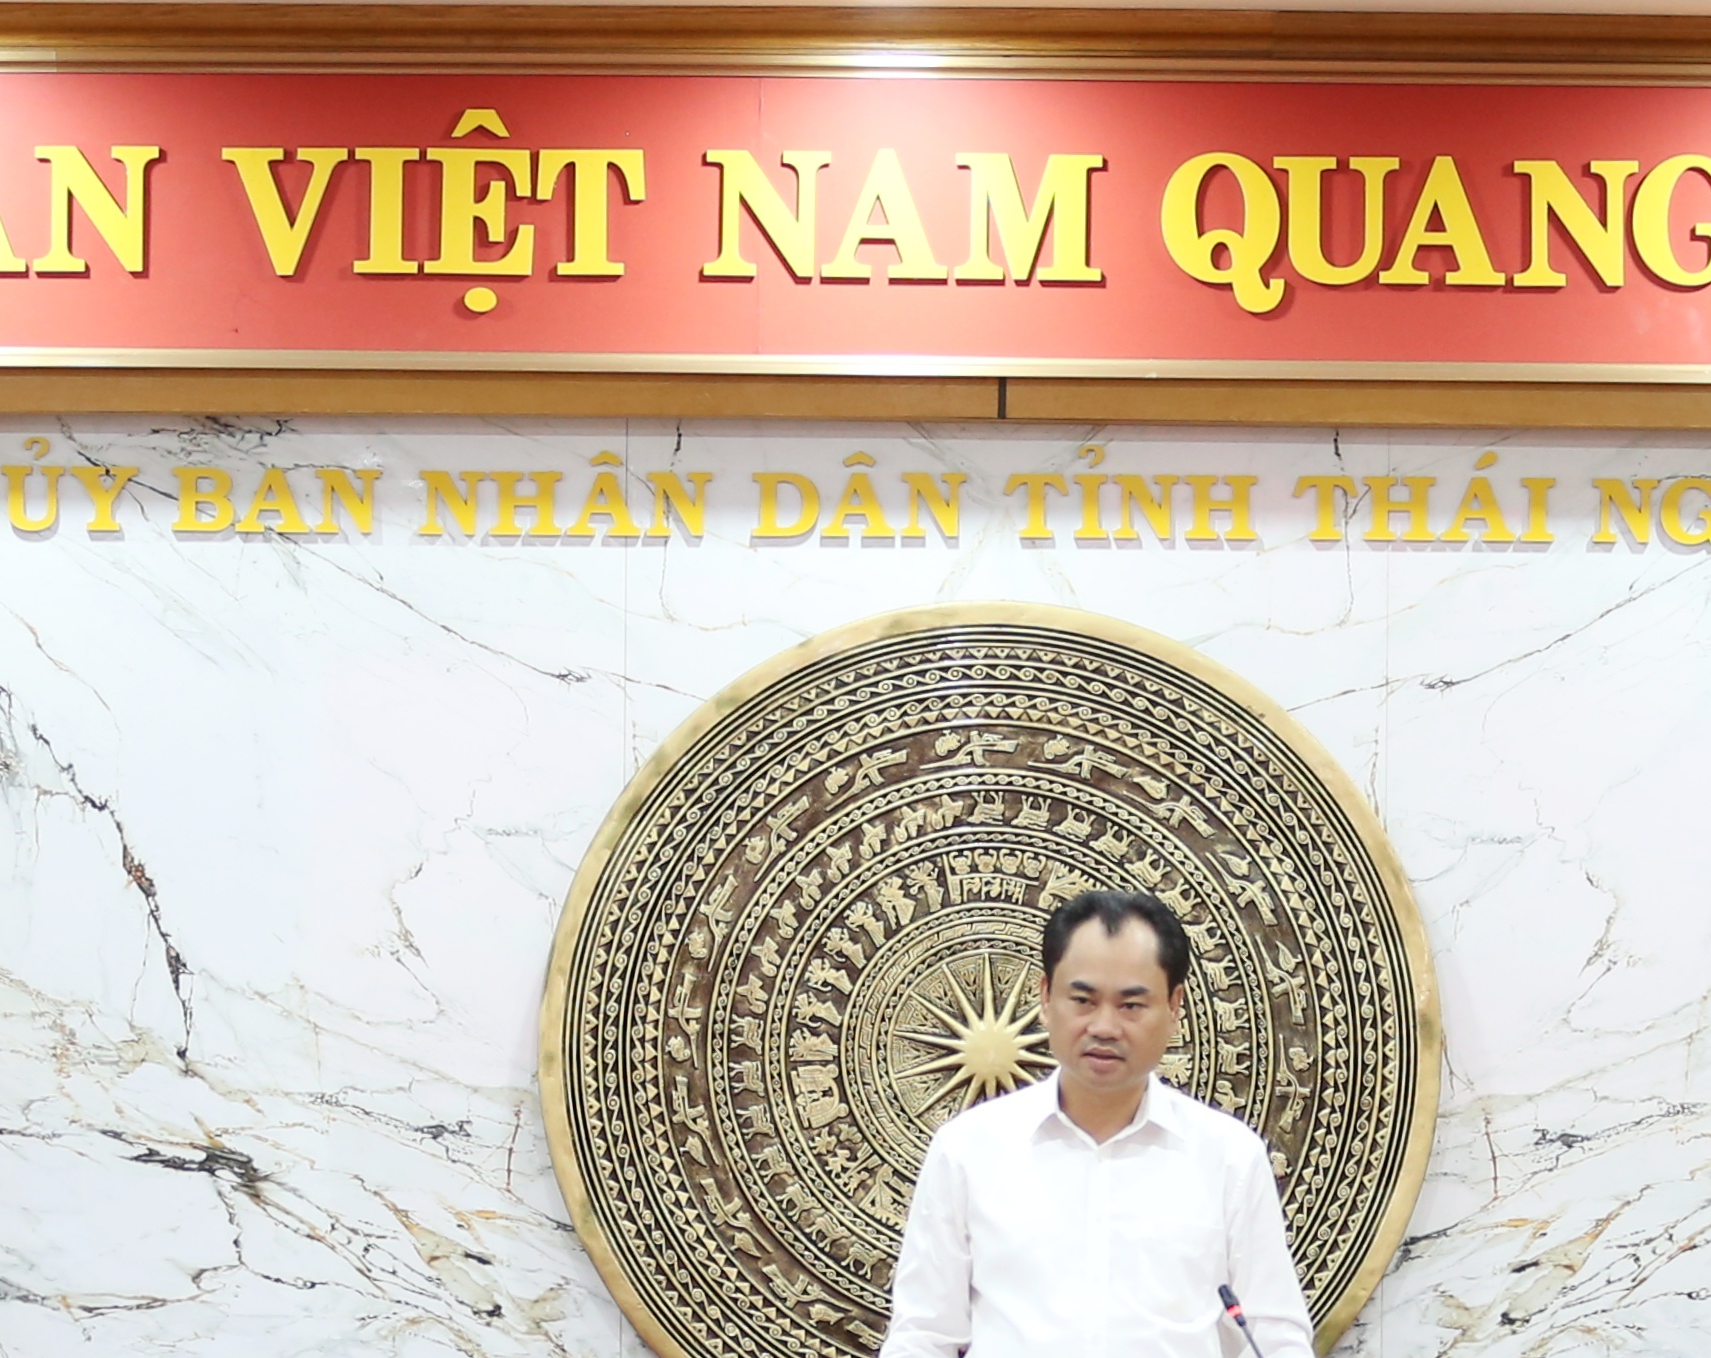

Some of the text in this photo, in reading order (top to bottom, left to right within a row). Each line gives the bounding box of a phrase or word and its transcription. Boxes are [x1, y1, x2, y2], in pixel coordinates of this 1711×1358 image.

[222, 109, 646, 312] VIỆT
[703, 150, 1103, 281] NAM
[2, 438, 137, 529] ỦY
[174, 468, 379, 532] BAN
[421, 452, 711, 535] NHÂN
[755, 453, 966, 535] DÂN
[1007, 446, 1256, 538] TỈNH
[1296, 452, 1555, 541] THÁI
